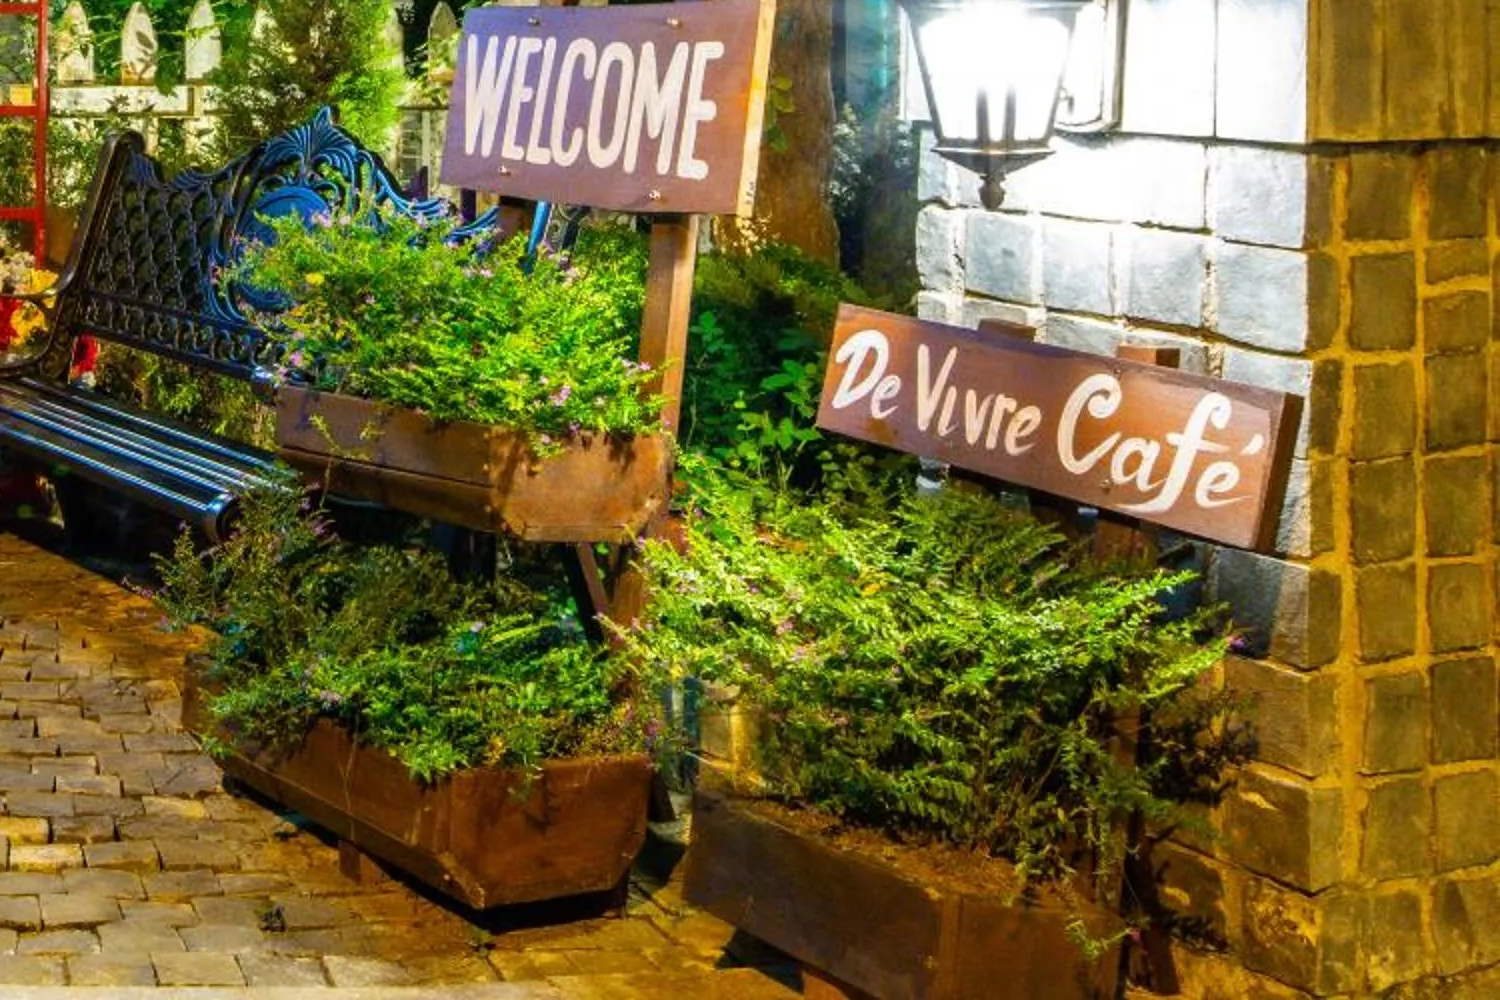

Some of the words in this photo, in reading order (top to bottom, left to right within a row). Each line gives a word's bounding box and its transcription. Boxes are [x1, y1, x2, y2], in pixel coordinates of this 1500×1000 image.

[465, 33, 725, 180] WELCOME
[831, 329, 901, 419] De
[917, 343, 1042, 456] Vivre
[1056, 373, 1268, 513] Café
